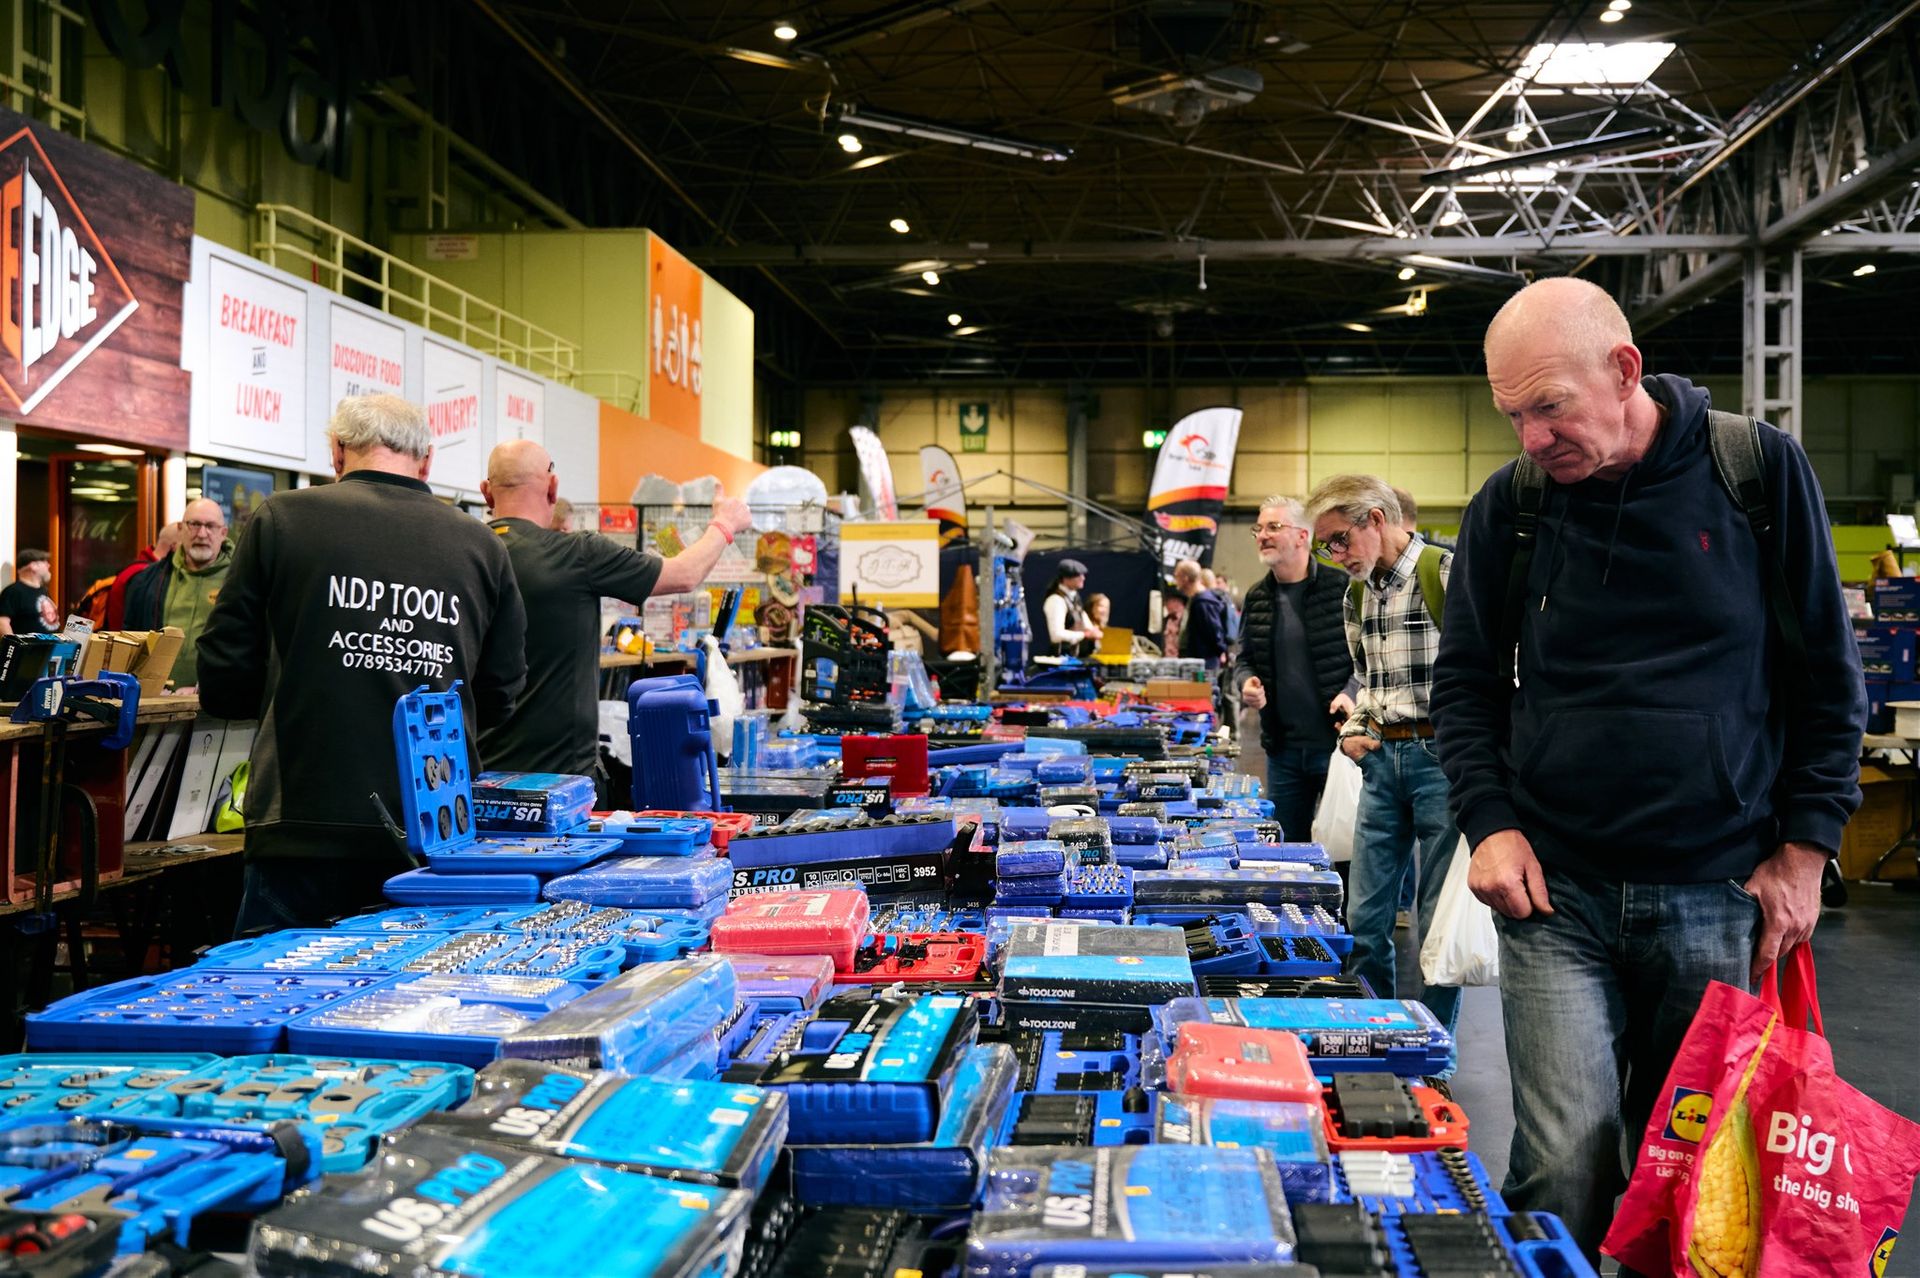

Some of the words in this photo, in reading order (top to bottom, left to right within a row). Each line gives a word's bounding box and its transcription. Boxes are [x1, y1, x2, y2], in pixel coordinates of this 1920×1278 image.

[23, 165, 97, 370] EDGE
[221, 293, 297, 349] BREAKFAST
[253, 352, 266, 369] AND
[333, 343, 377, 381] DISCOVER
[380, 359, 402, 387] FOOD
[236, 382, 282, 424] LUNCH
[428, 395, 478, 437] HUNGRY?
[328, 575, 385, 612] N.D.P
[390, 582, 460, 626] TOOLS
[379, 617, 414, 633] AND
[328, 630, 454, 664] ACCESSORIES
[343, 652, 443, 678] 07895347172
[732, 868, 797, 888] S.PRO
[914, 866, 937, 878] 3952
[1029, 988, 1076, 998] TOOLZONE
[1029, 1020, 1077, 1030] TOOLZONE
[1324, 1045, 1340, 1054] PSI
[1348, 1046, 1368, 1054] BAR
[1648, 1144, 1667, 1161] Big
[1668, 1150, 1684, 1161] on
[1766, 1111, 1836, 1176] Big
[1773, 1173, 1801, 1197] the
[1802, 1182, 1832, 1209] big
[1836, 1190, 1860, 1214] sho
